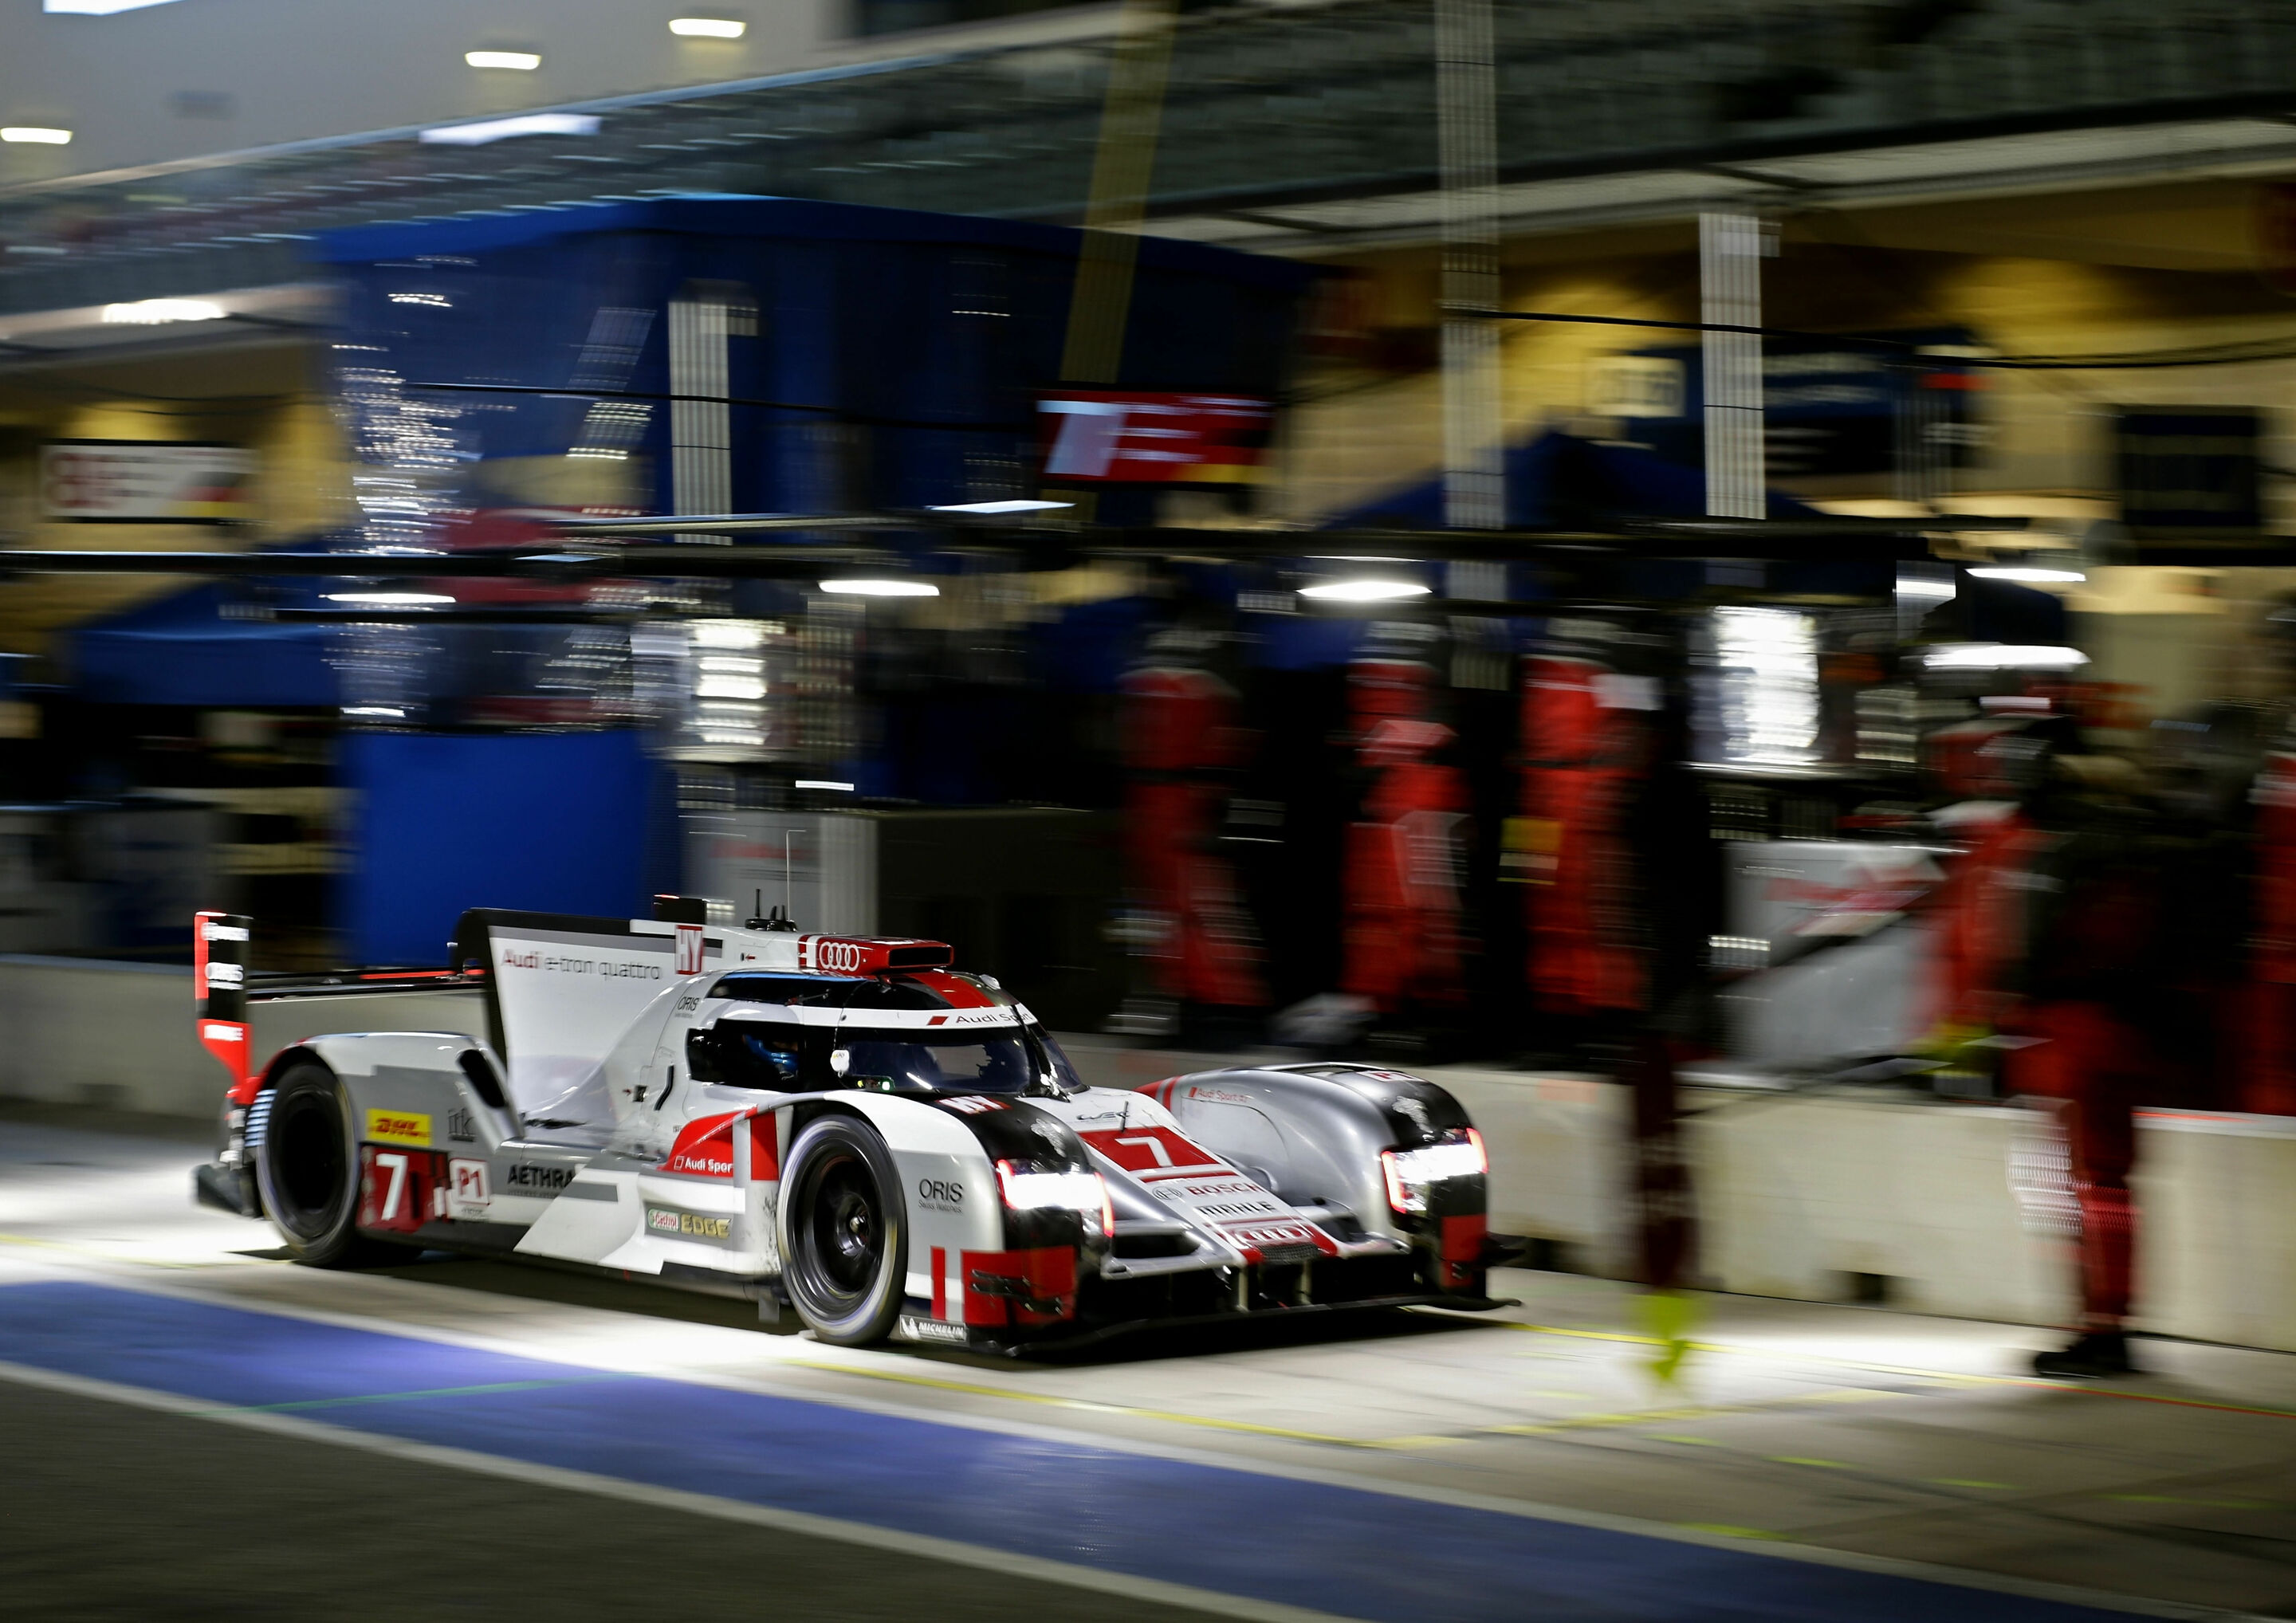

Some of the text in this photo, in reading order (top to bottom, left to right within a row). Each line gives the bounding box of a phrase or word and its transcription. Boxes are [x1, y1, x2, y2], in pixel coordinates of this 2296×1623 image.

[502, 949, 662, 980] Audi e-tron quattro
[678, 996, 699, 1011] ORIS
[956, 1014, 997, 1024] Audi
[1197, 1088, 1214, 1098] Audi
[375, 1117, 420, 1136] DHL
[1115, 1136, 1174, 1167] 7
[685, 1157, 733, 1173] Audi Spor
[375, 1153, 408, 1221] 7
[458, 1168, 482, 1197] P1
[919, 1179, 963, 1202] ORIS
[1185, 1182, 1265, 1196] BOSCH
[1197, 1201, 1275, 1216] MAHLE
[655, 1212, 678, 1229] Castrol
[681, 1213, 730, 1239] EDGE
[918, 1322, 964, 1338] MICHELIN
